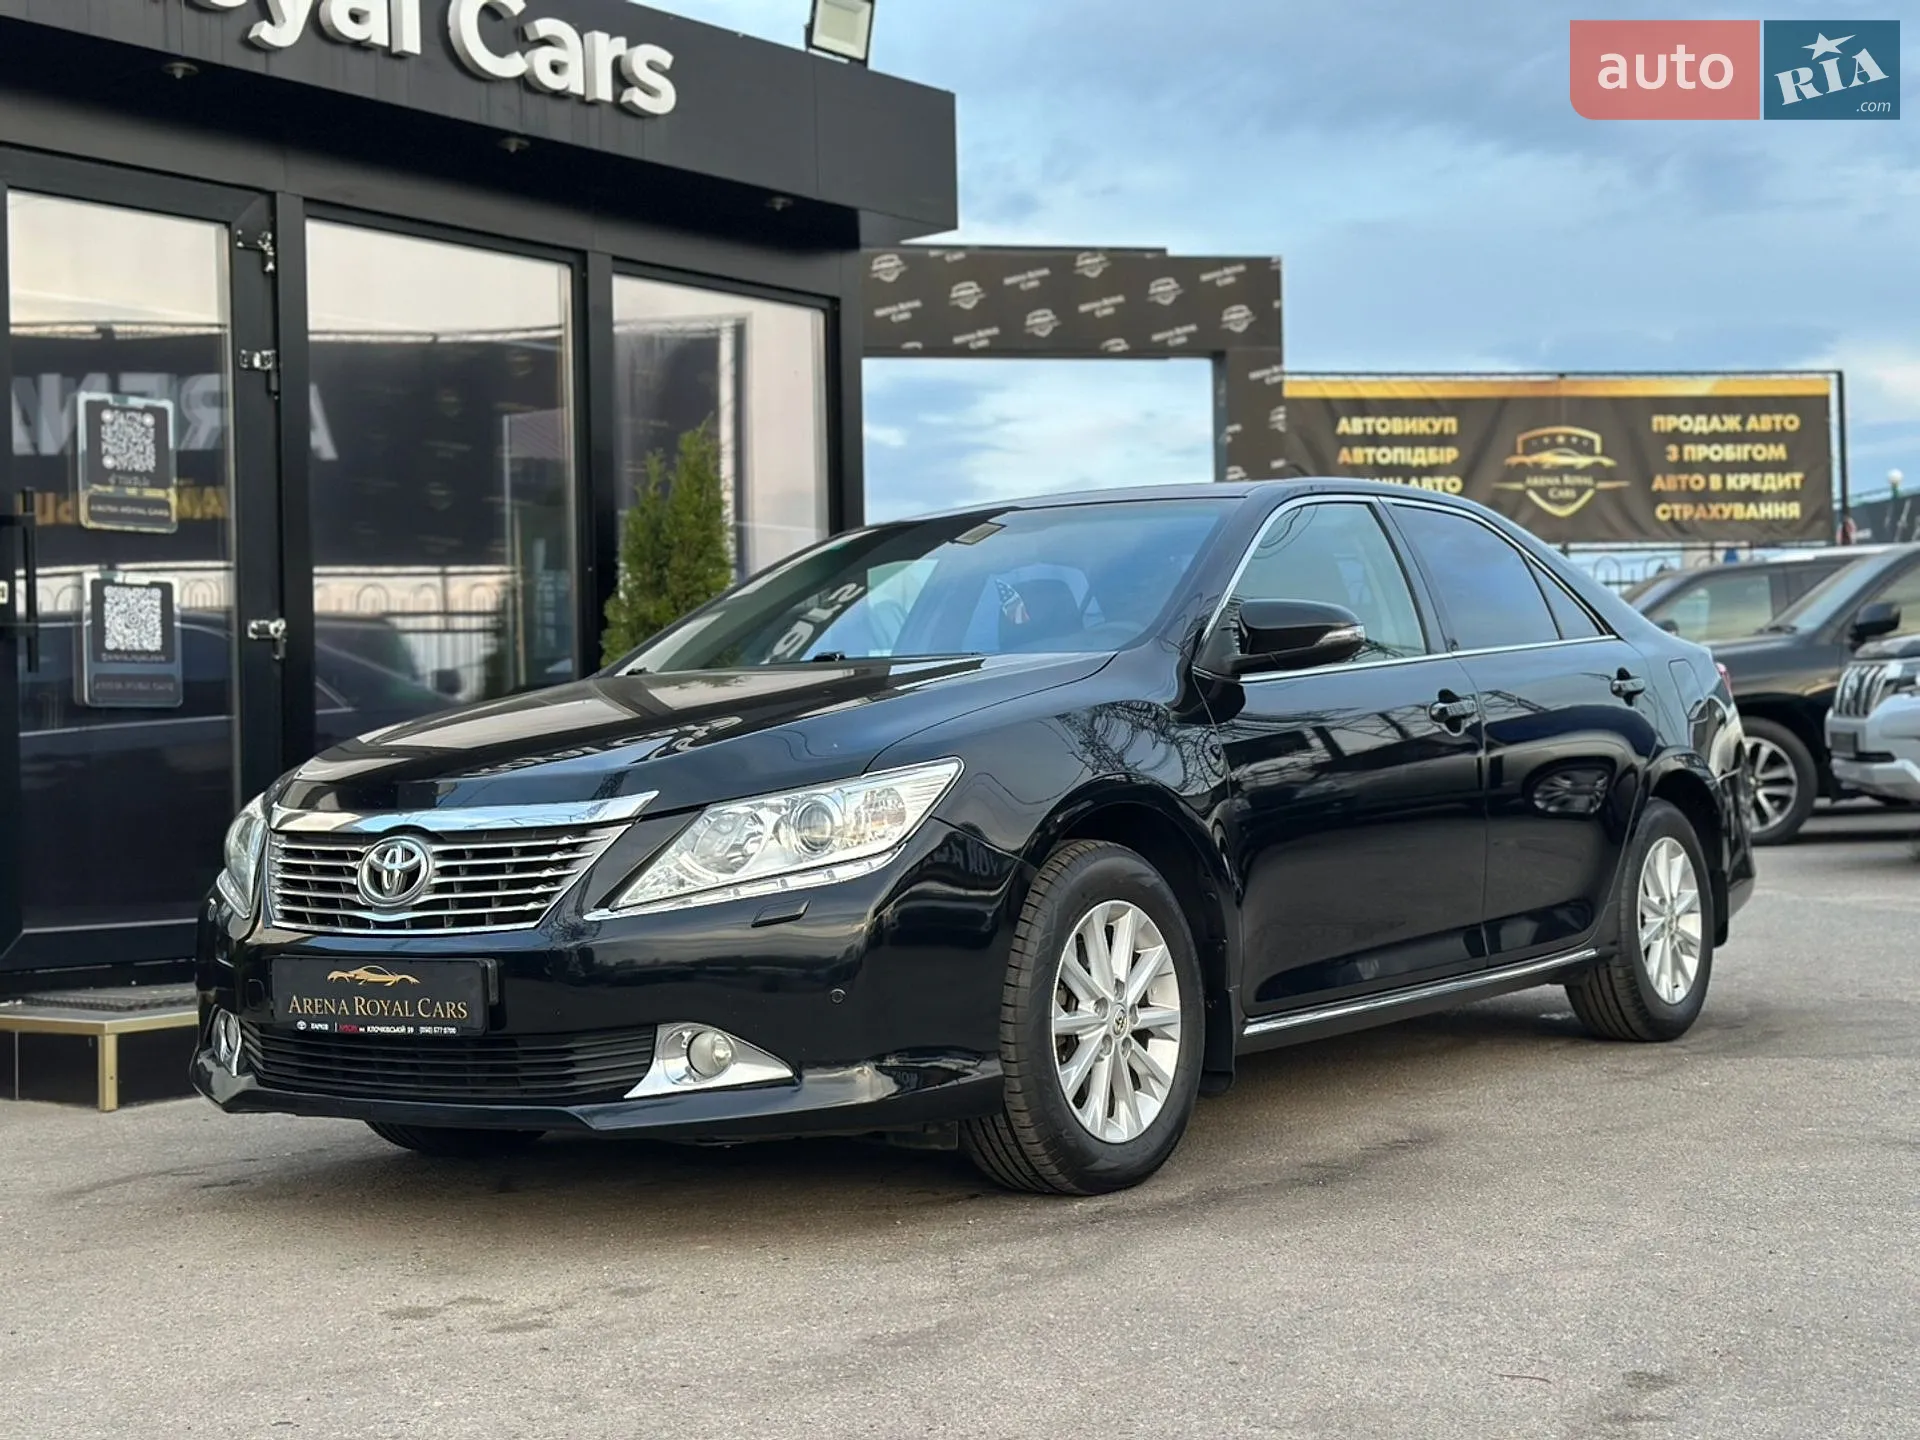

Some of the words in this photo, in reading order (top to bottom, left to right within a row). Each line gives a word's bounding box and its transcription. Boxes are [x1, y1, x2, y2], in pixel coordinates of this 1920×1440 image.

[186, 0, 421, 54] yal
[448, 0, 676, 116] Cars
[1336, 416, 1458, 435] АВТОВИКУП
[1652, 414, 1742, 434] ПРОДАЖ
[1746, 414, 1801, 432] АВТО
[1337, 446, 1460, 467] АВТОПІДБІР
[1682, 443, 1787, 461] ПРОБІГОМ
[1652, 473, 1706, 491] АВТО
[1709, 473, 1722, 491] В
[1725, 472, 1804, 492] КРЕДИТ
[1655, 502, 1801, 521] СТРАХУВАННЯ
[288, 995, 350, 1015] ARENA
[354, 996, 415, 1017] ROYAL
[417, 997, 468, 1019] CARS
